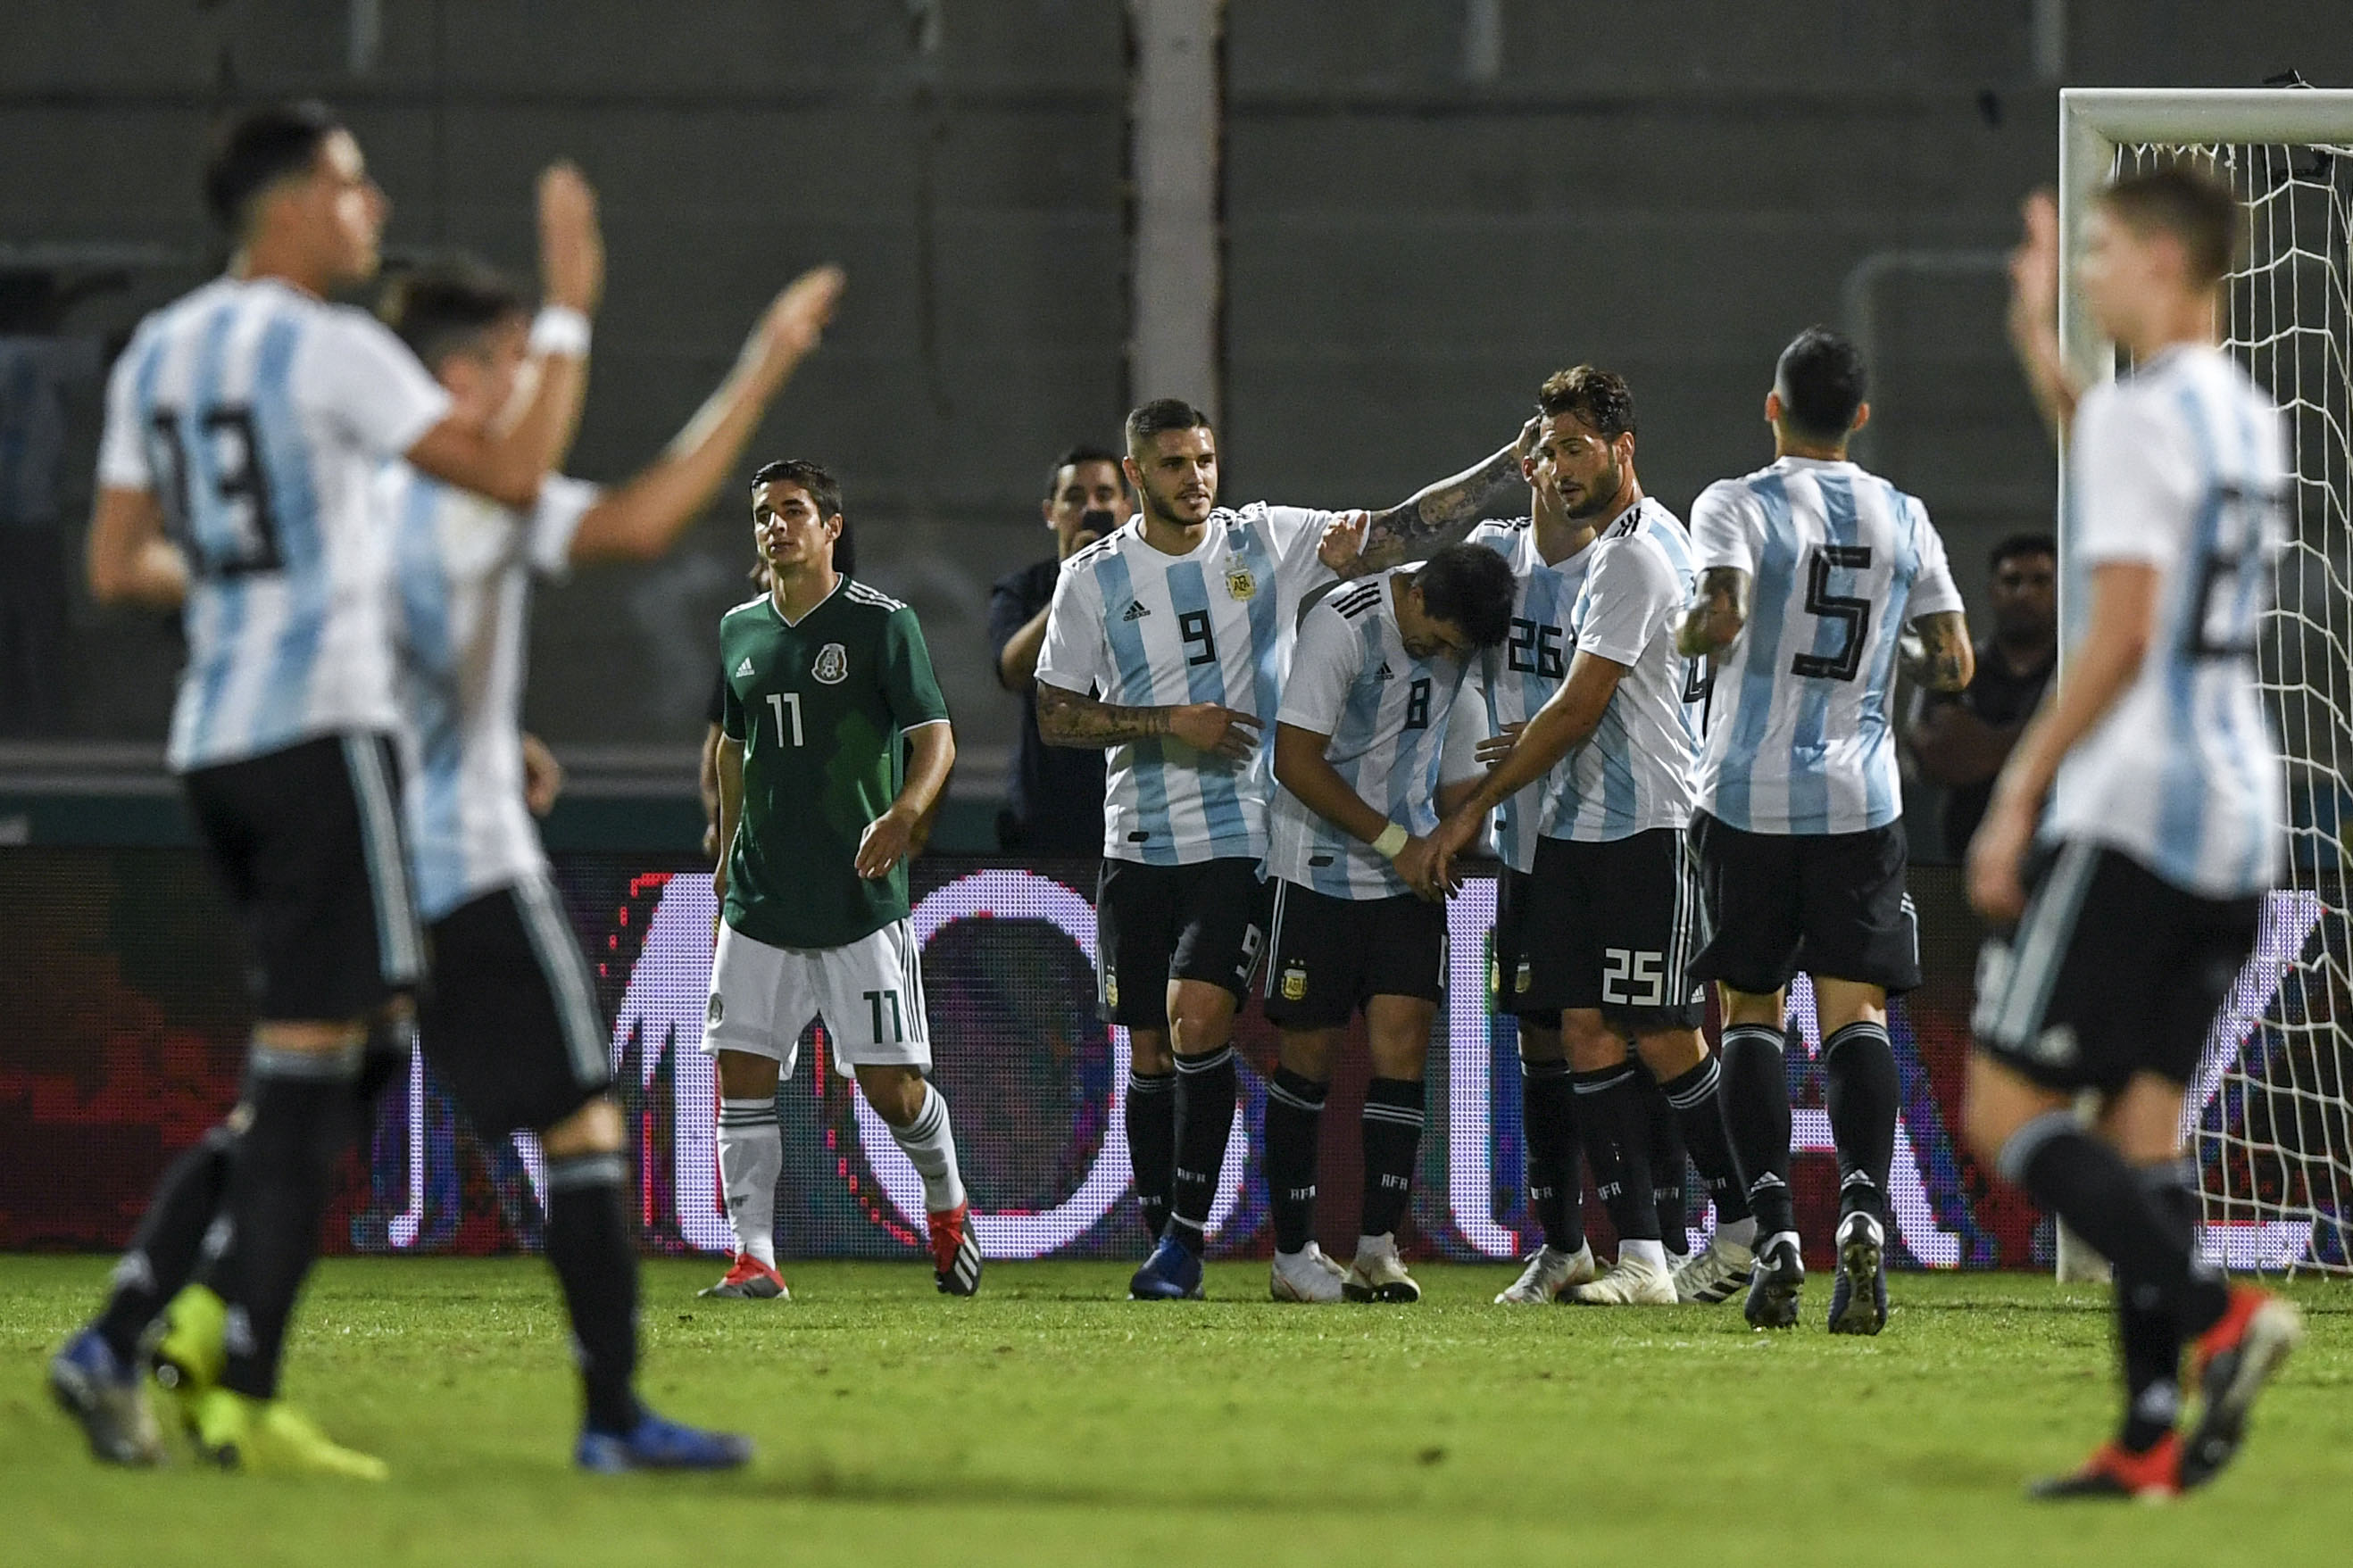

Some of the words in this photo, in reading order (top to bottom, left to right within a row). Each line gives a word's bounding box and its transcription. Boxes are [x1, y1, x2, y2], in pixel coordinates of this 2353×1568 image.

[1178, 609, 1217, 667] 9
[1791, 544, 1872, 682] 5
[1509, 617, 1564, 679] 26
[766, 693, 804, 749] 11
[1405, 677, 1431, 729] 8
[1602, 948, 1663, 1006] 25
[862, 989, 903, 1044] 11
[1381, 1174, 1409, 1191] AFA
